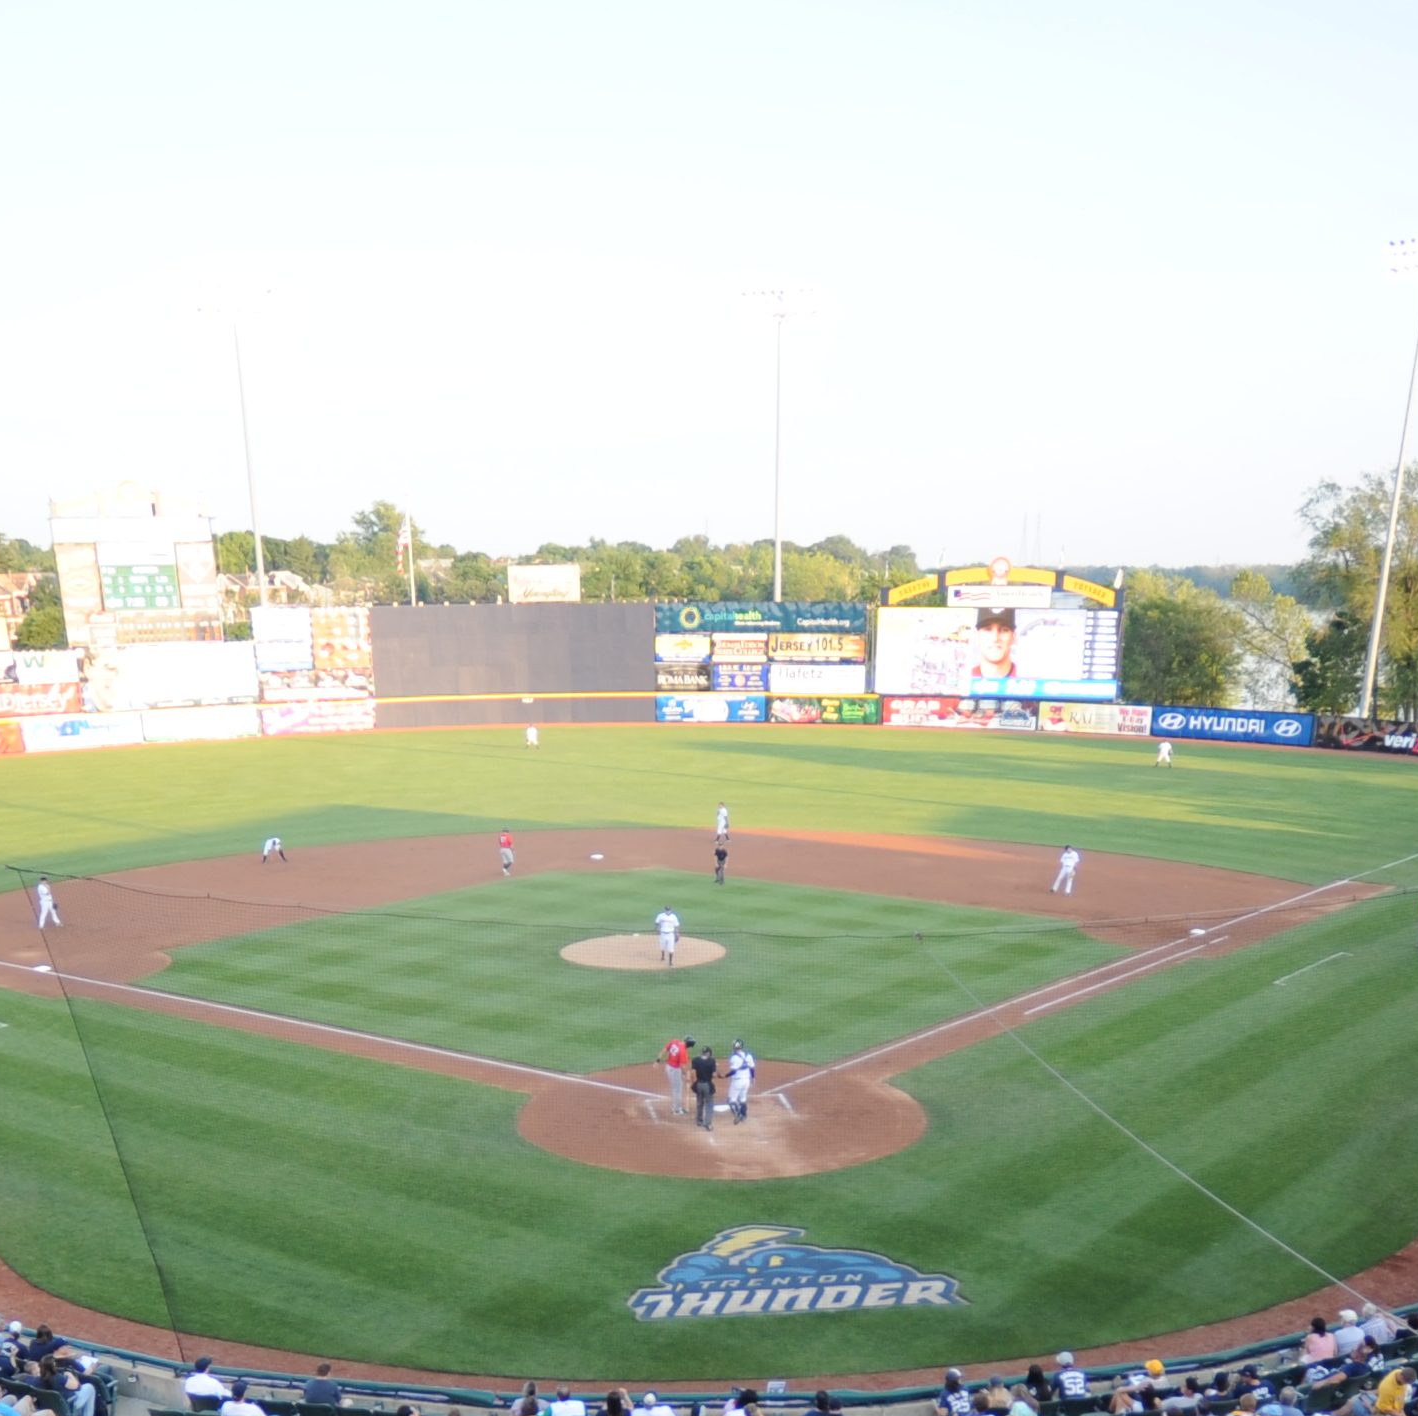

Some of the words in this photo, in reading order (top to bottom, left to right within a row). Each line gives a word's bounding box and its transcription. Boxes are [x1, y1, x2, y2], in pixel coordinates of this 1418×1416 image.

[771, 635, 812, 652] JERSEY
[815, 636, 844, 651] 101.5
[658, 674, 683, 685] ROMA
[684, 674, 708, 685] BANK
[890, 700, 941, 710] GRAB
[890, 714, 940, 723] BUDS
[1189, 715, 1265, 734] HYUNDAI
[698, 1272, 865, 1289] TRENTON
[636, 1279, 953, 1319] THUNDER
[1064, 1377, 1085, 1395] 52
